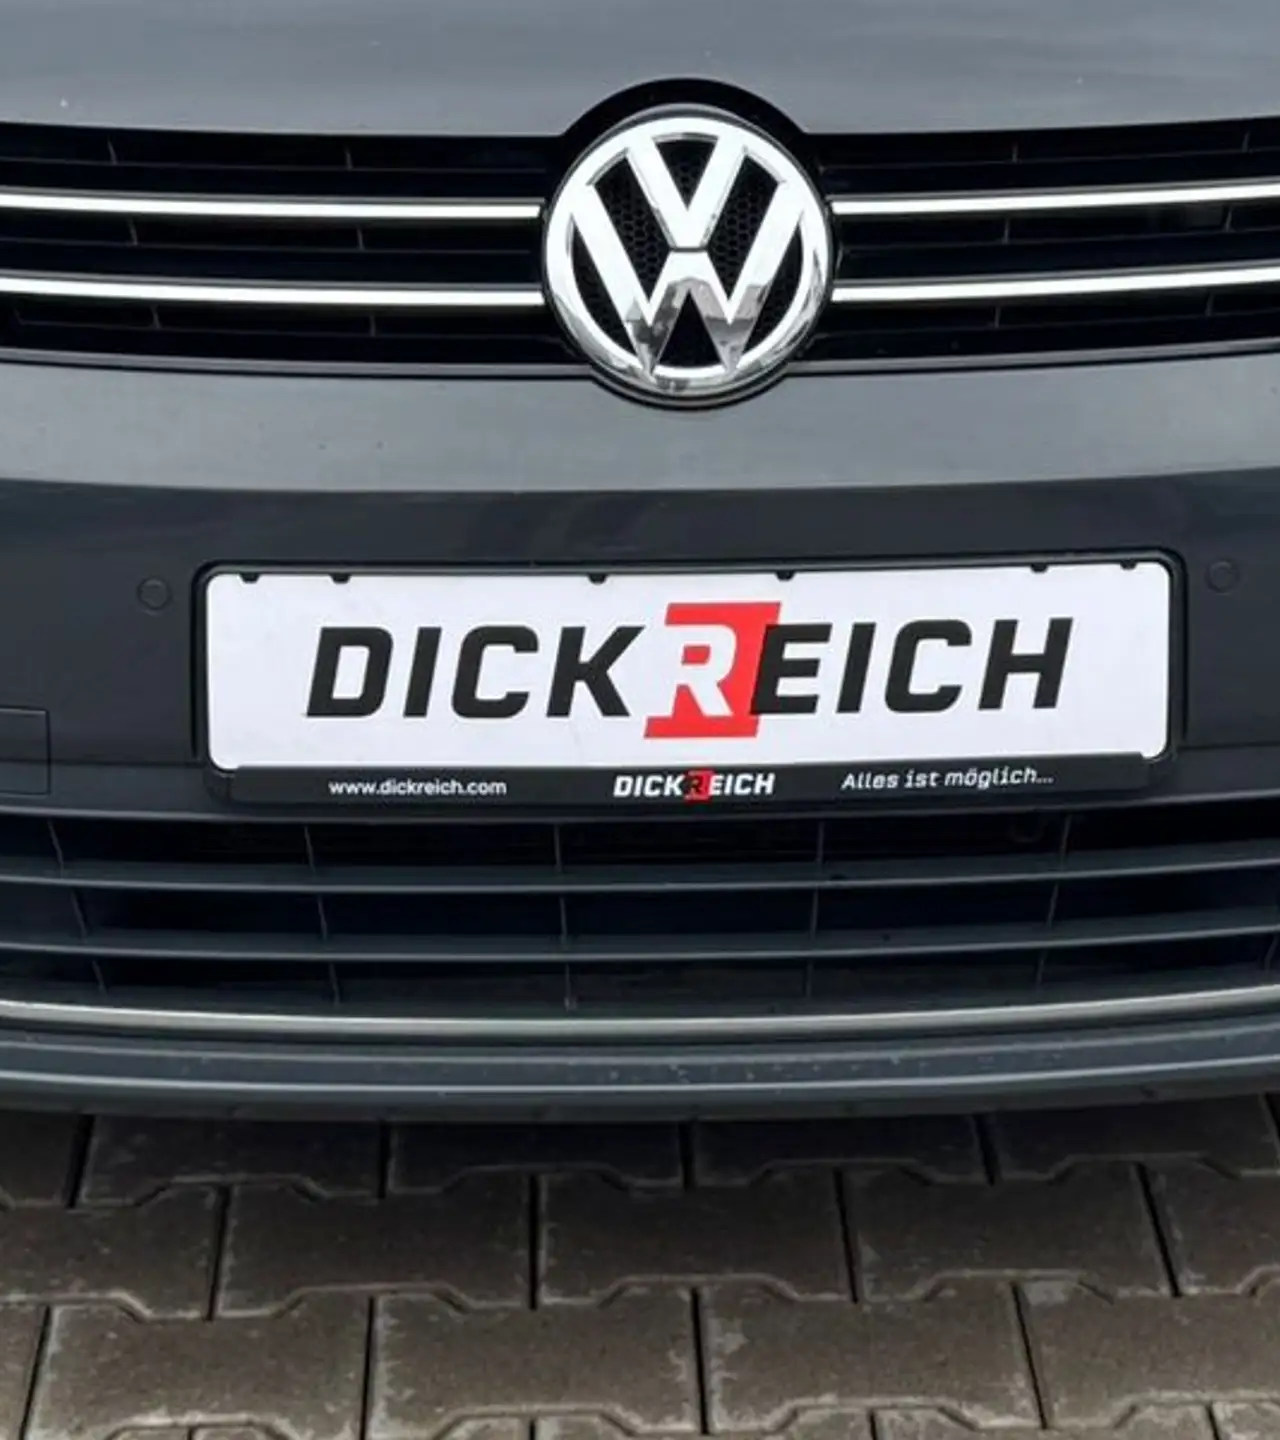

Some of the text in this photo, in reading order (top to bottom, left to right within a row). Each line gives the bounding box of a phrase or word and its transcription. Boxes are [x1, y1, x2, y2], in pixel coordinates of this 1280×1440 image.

[548, 117, 828, 395] VW
[305, 615, 1074, 720] DICKREICH
[328, 778, 507, 795] www.dickreich.com
[613, 769, 776, 798] DICKREICH
[840, 770, 899, 790] Alles
[903, 768, 940, 788] ist
